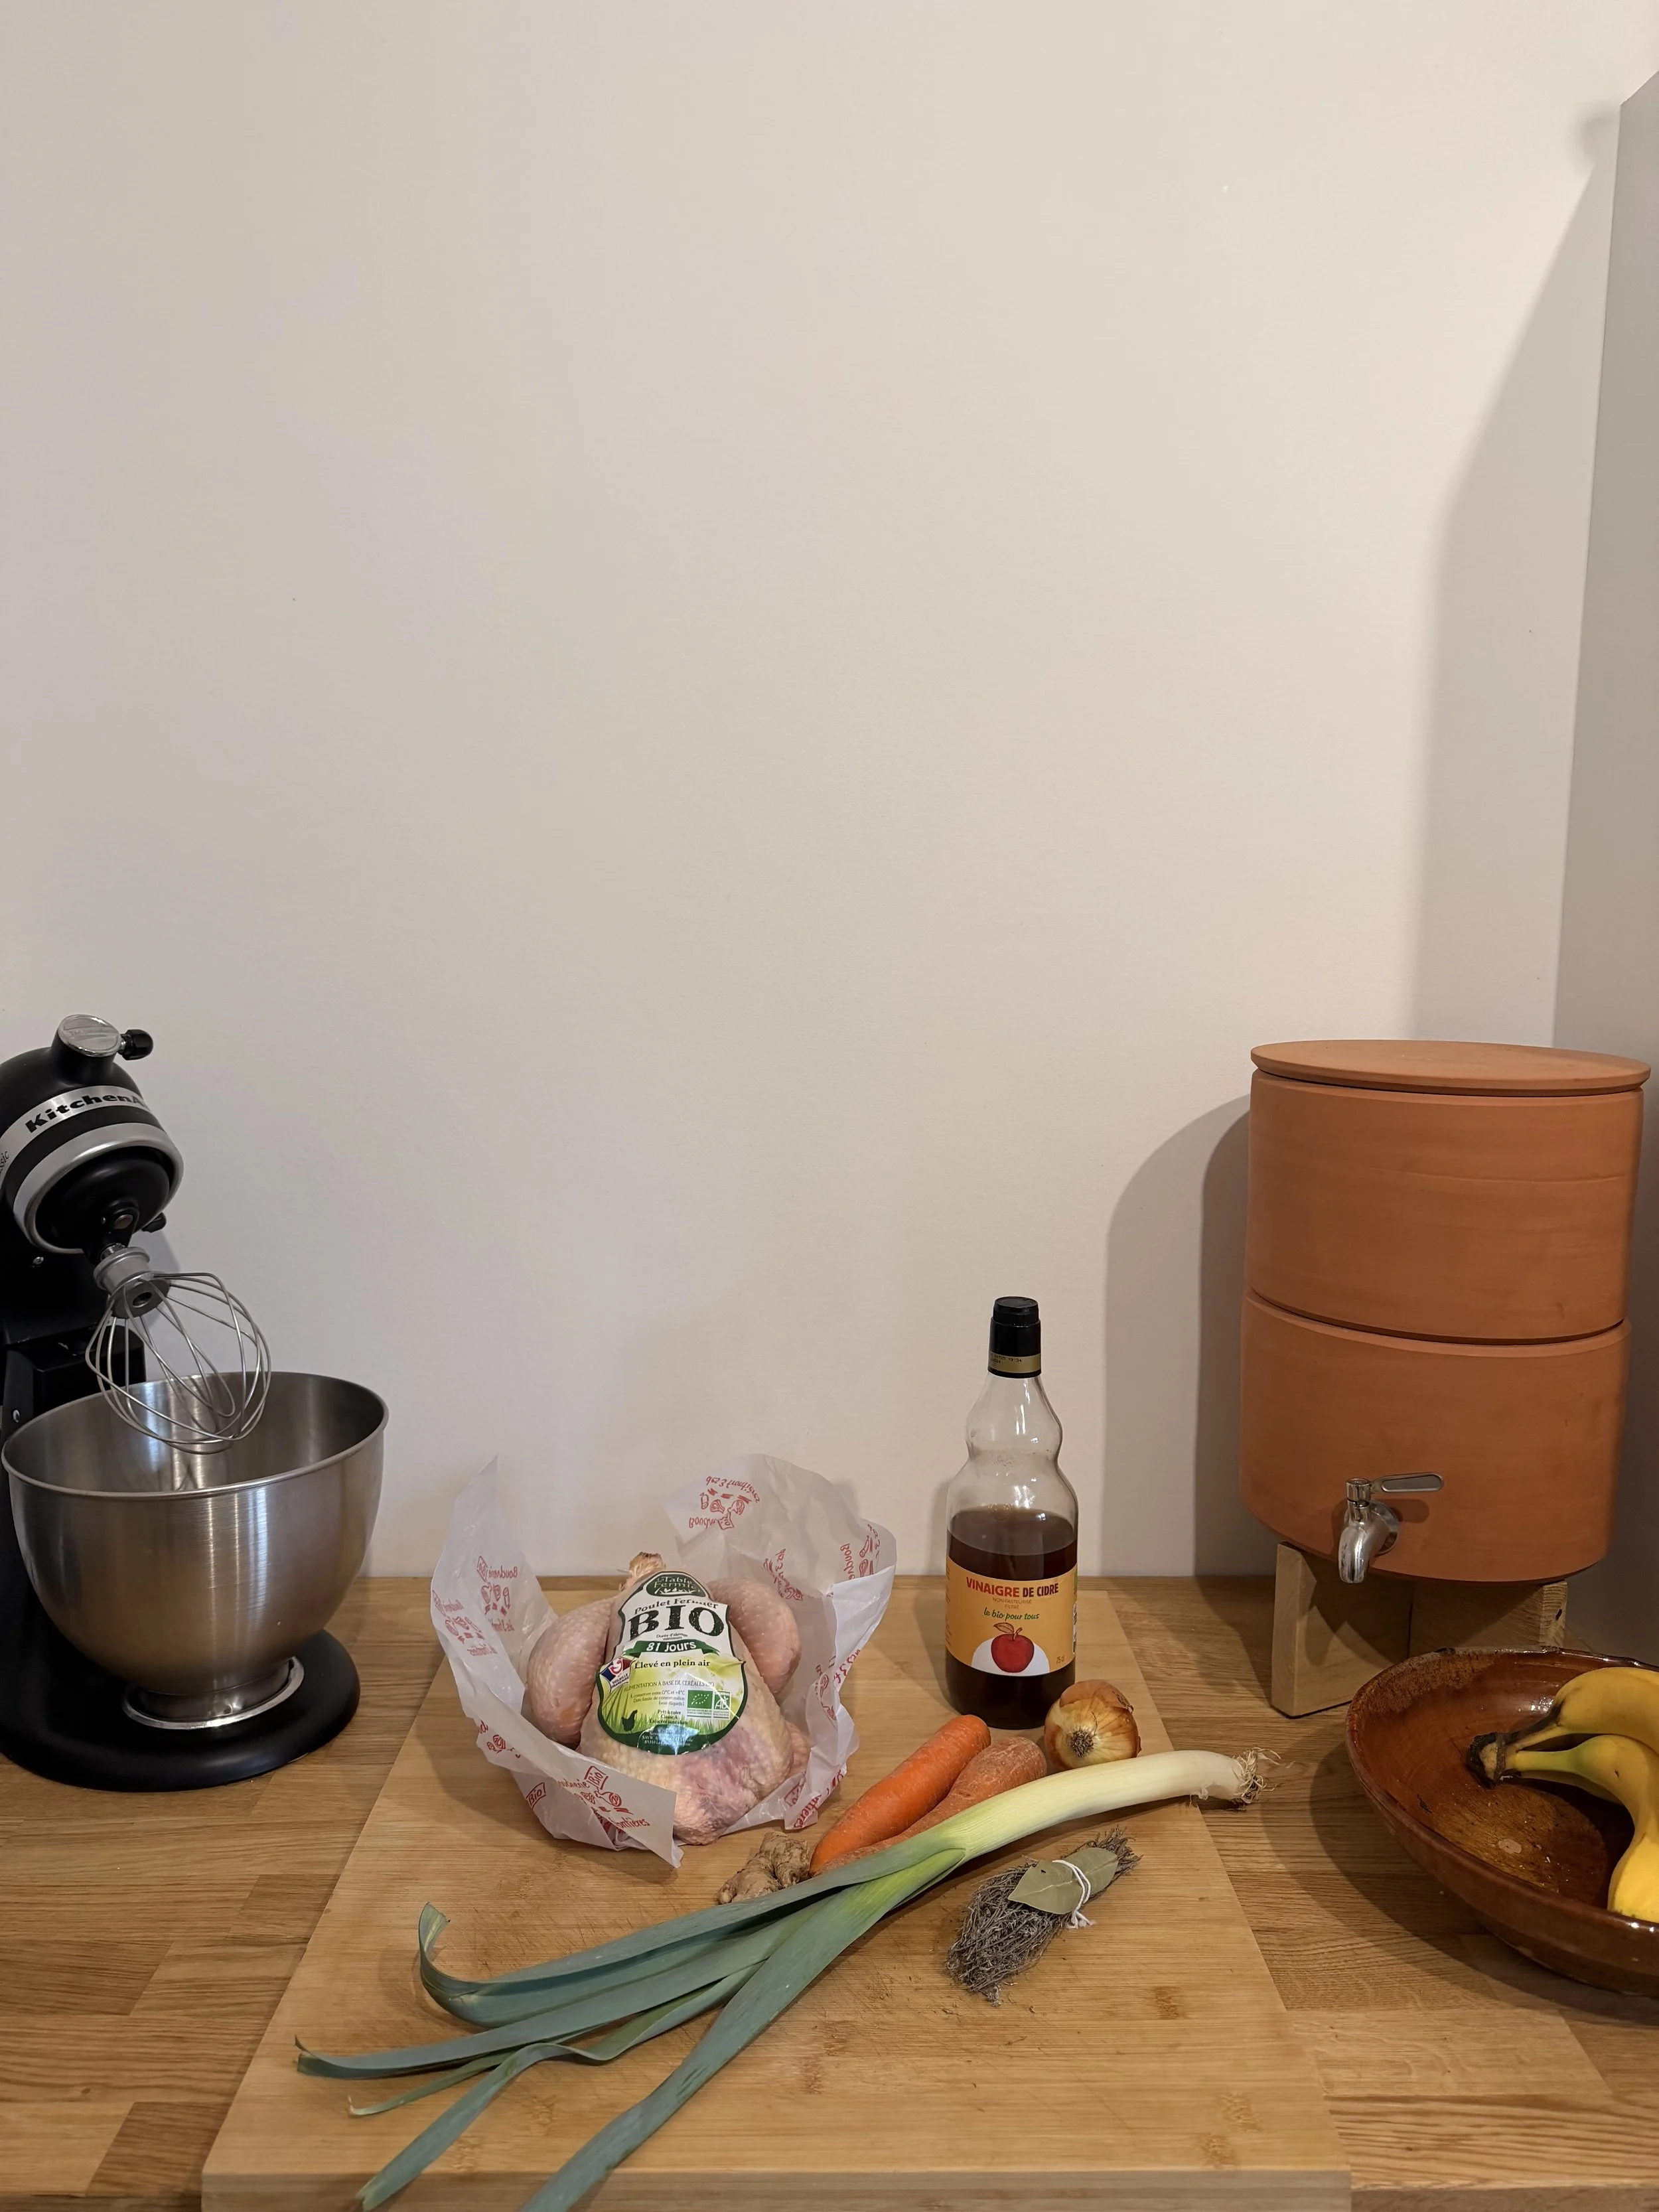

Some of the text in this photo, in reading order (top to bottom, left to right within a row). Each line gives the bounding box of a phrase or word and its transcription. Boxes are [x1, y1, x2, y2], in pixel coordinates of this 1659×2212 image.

[966, 1577, 1020, 1597] VINAIGRE
[1023, 1587, 1034, 1597] DE
[1037, 1583, 1059, 1597] CIDRE
[634, 1600, 670, 1615] Poulet
[984, 1607, 991, 1616] le
[991, 1609, 1005, 1619] bio
[1005, 1613, 1023, 1621] pour
[628, 1605, 724, 1642] BIO
[646, 1641, 697, 1652] 81 jours
[634, 1659, 658, 1669] Élevé
[673, 1659, 695, 1668] plein
[623, 1681, 658, 1691] ALIMENTATION
